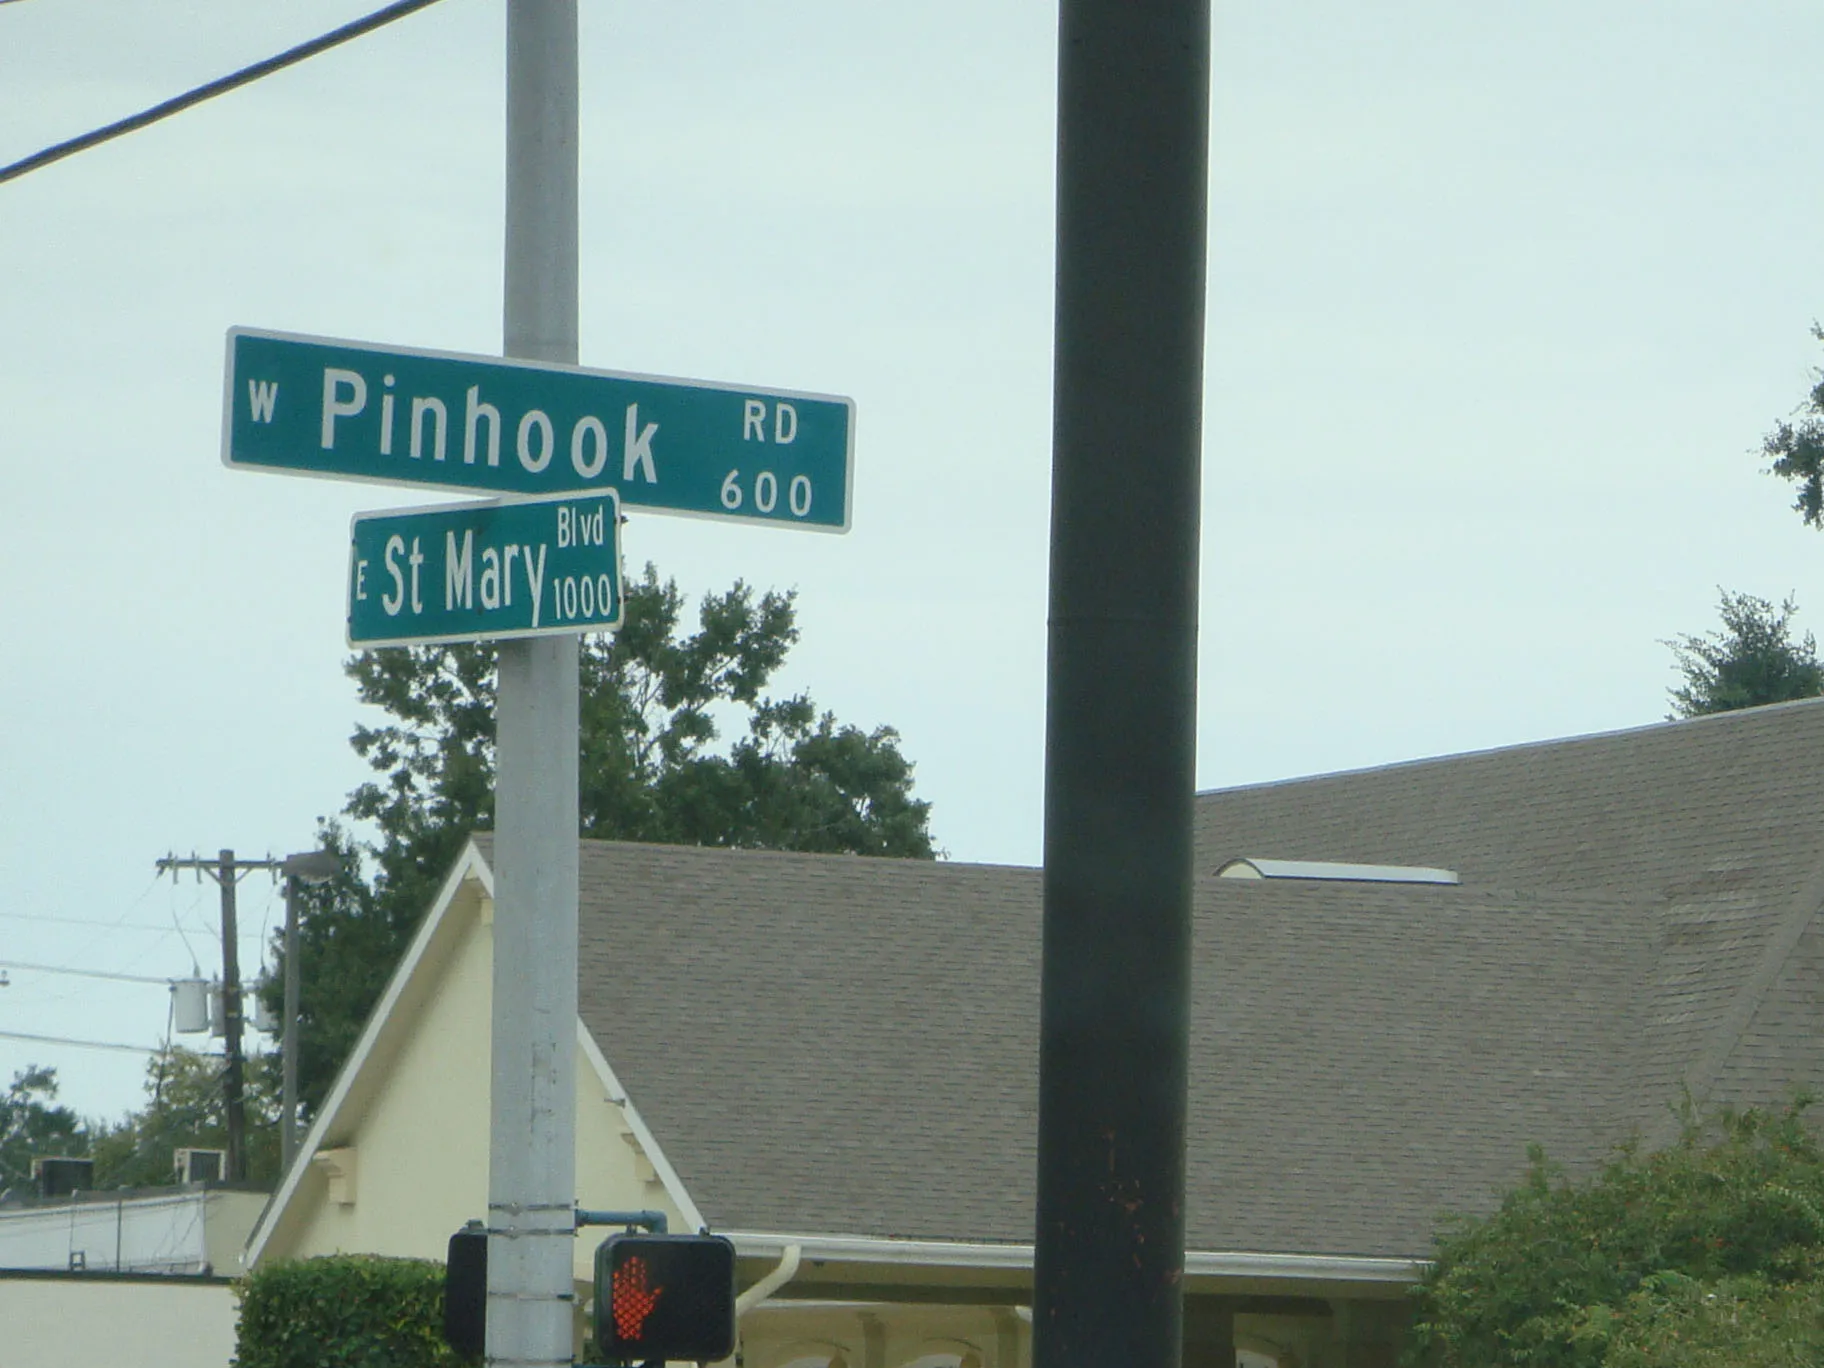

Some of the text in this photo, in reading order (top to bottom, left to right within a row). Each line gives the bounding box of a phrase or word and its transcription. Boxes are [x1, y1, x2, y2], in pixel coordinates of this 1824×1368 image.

[249, 368, 797, 484] W Pinhook RD
[720, 469, 813, 517] 600
[356, 505, 604, 628] E St Mary Blvd
[553, 573, 612, 620] 1000
